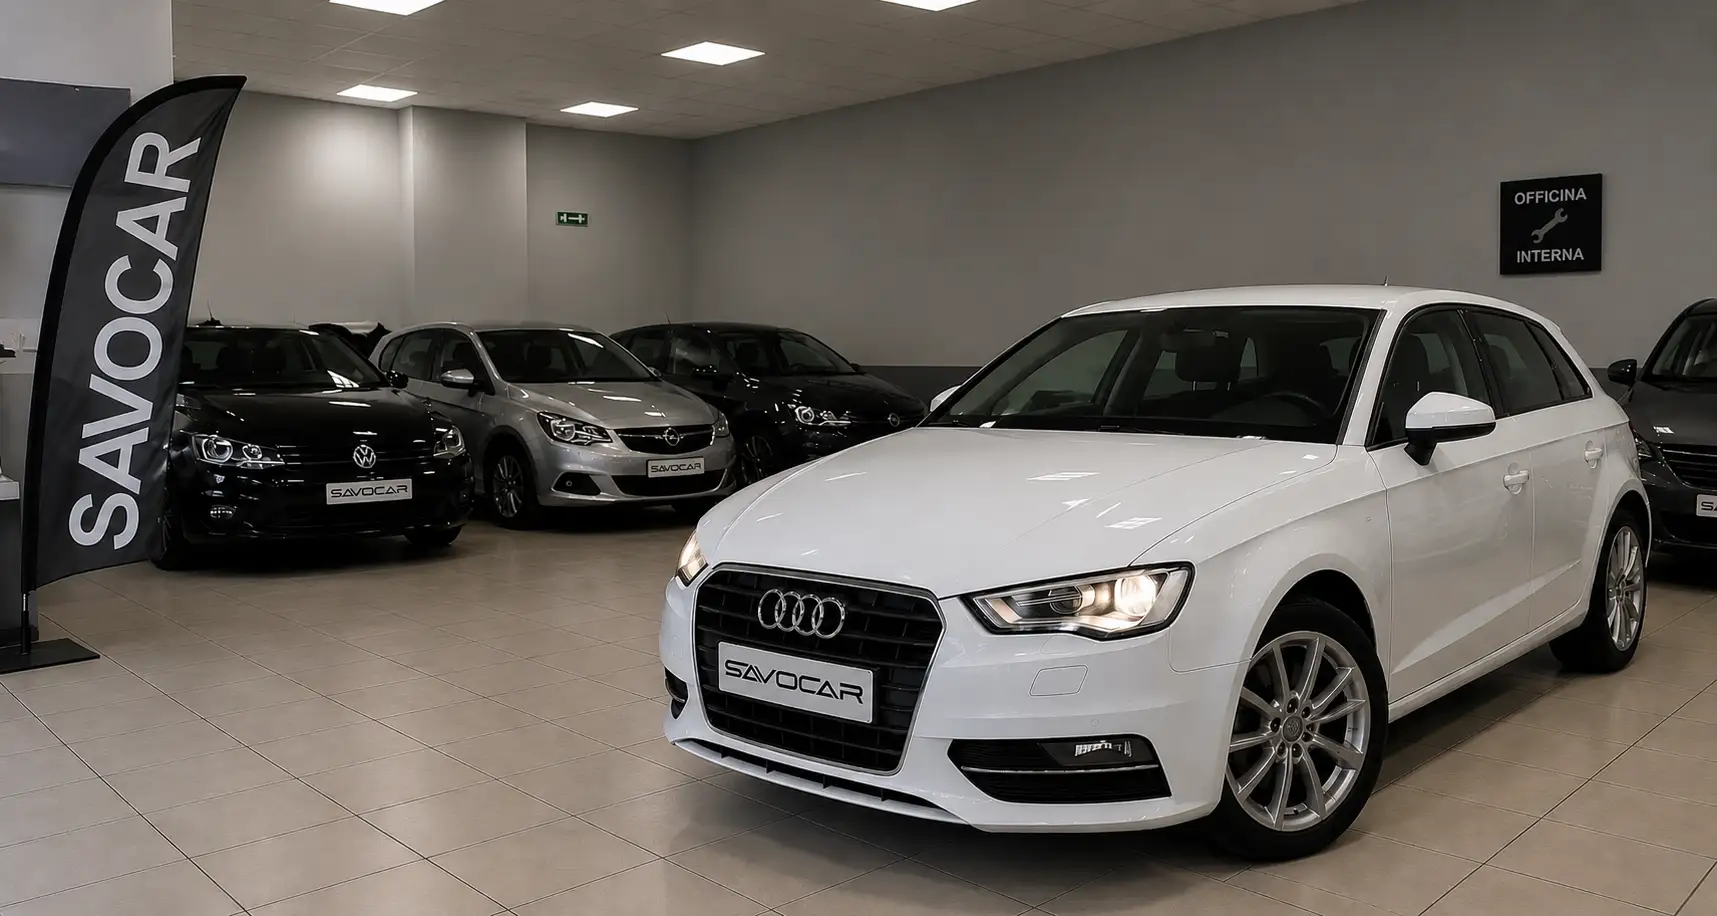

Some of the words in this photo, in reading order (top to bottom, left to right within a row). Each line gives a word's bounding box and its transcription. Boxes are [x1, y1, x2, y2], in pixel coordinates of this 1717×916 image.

[1514, 188, 1587, 205] OFFICINA
[1517, 248, 1584, 263] INTERNA
[69, 131, 201, 549] SAVOCAR
[651, 463, 702, 473] SAVOCAR
[330, 485, 408, 498] SAVOCAR
[1701, 501, 1717, 511] S
[724, 659, 864, 705] SAVOCAR
